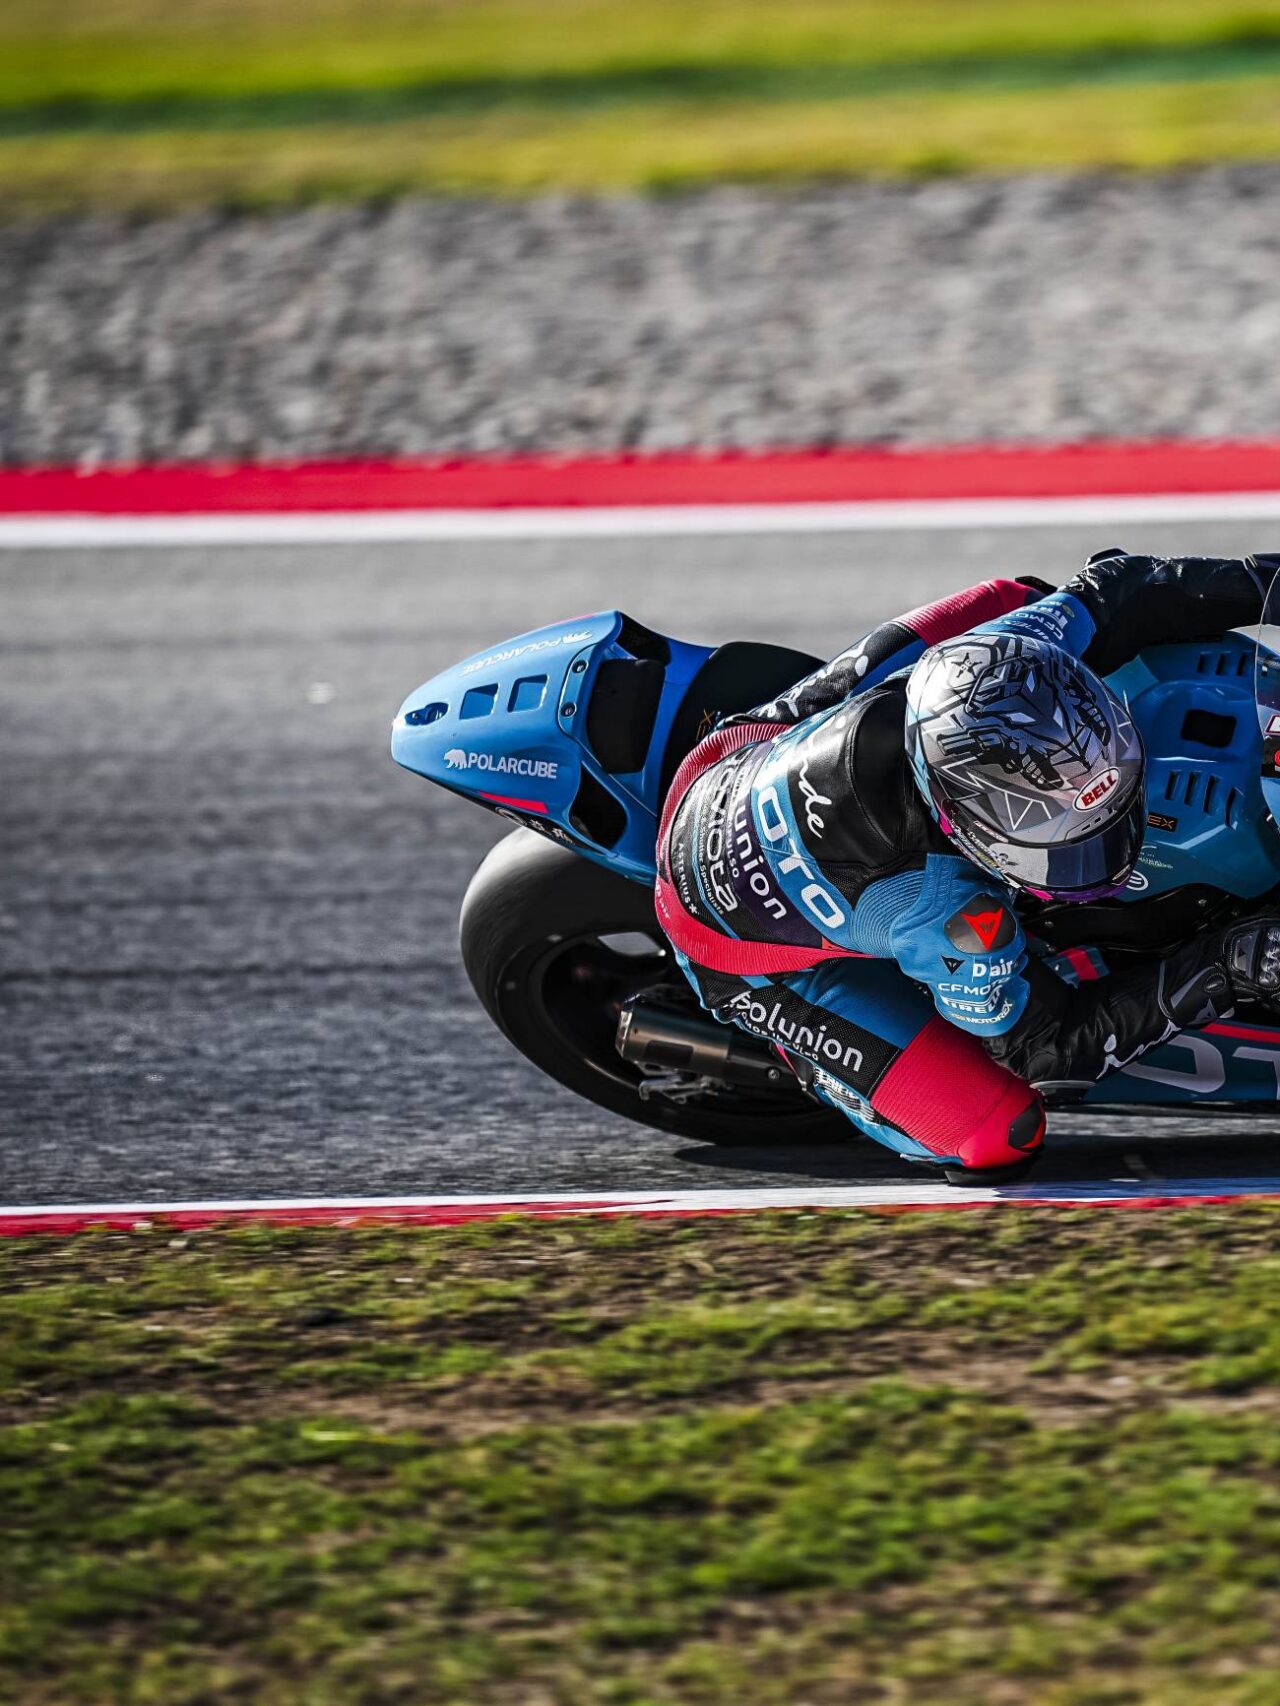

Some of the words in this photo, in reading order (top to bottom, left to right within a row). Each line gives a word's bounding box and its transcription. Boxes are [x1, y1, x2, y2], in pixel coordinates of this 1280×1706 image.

[458, 637, 562, 677] POLARCUBE
[467, 752, 558, 779] POLARCUBE
[1080, 773, 1117, 807] BELL
[938, 977, 1011, 996] CFMOTO
